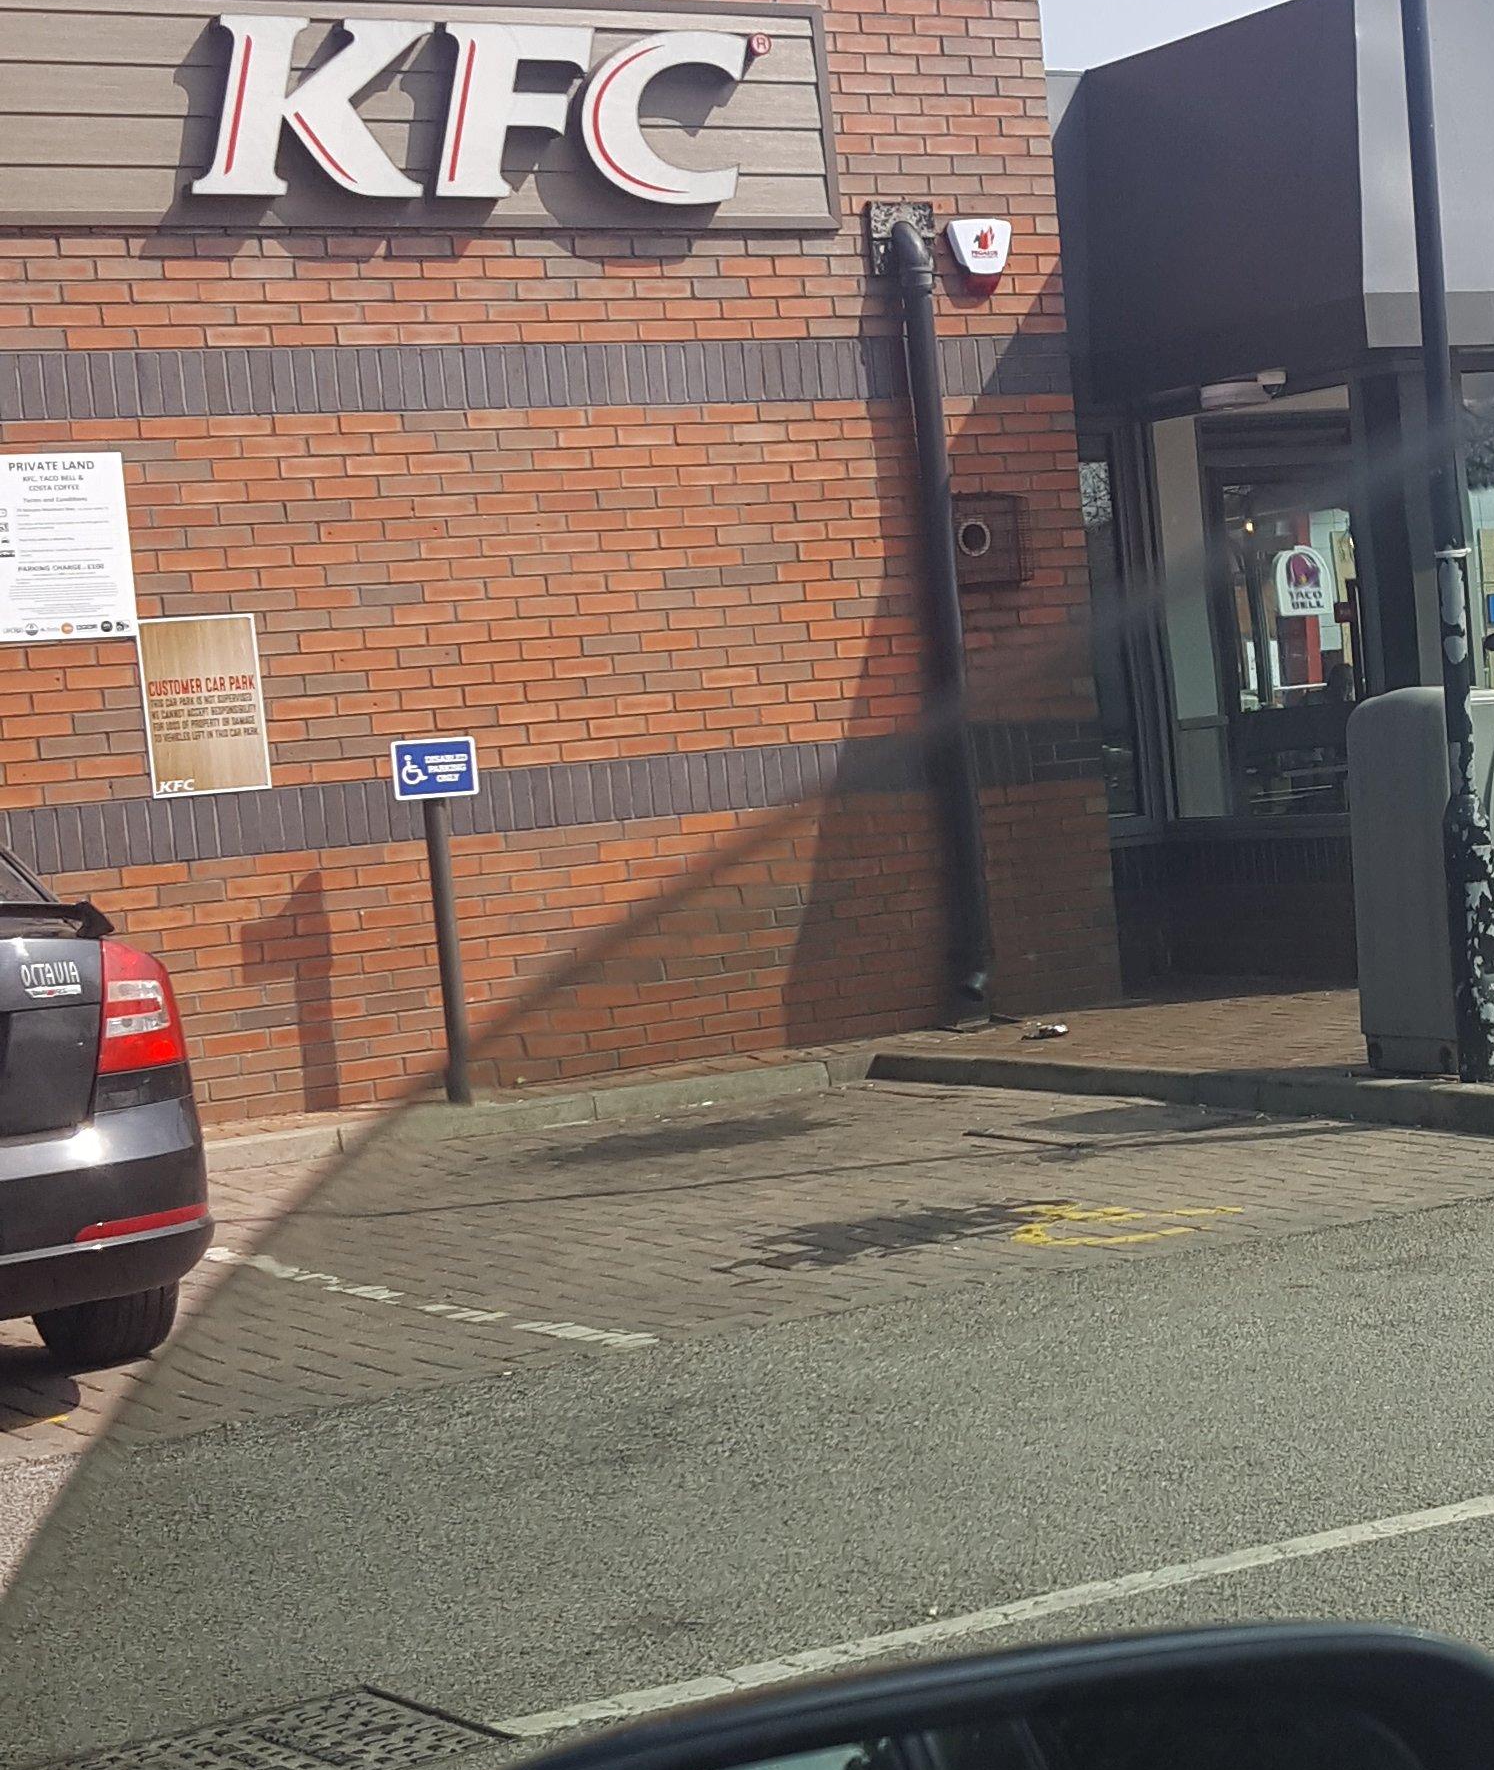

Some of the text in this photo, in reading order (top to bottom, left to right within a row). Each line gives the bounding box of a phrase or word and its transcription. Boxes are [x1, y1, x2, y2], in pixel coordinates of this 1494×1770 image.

[191, 13, 748, 205] KFC
[8, 460, 95, 471] PRIVATE LAND
[148, 675, 256, 697] CUSTOMER CAR PARK
[157, 779, 195, 794] KFC
[20, 961, 80, 987] OCTAVIA
